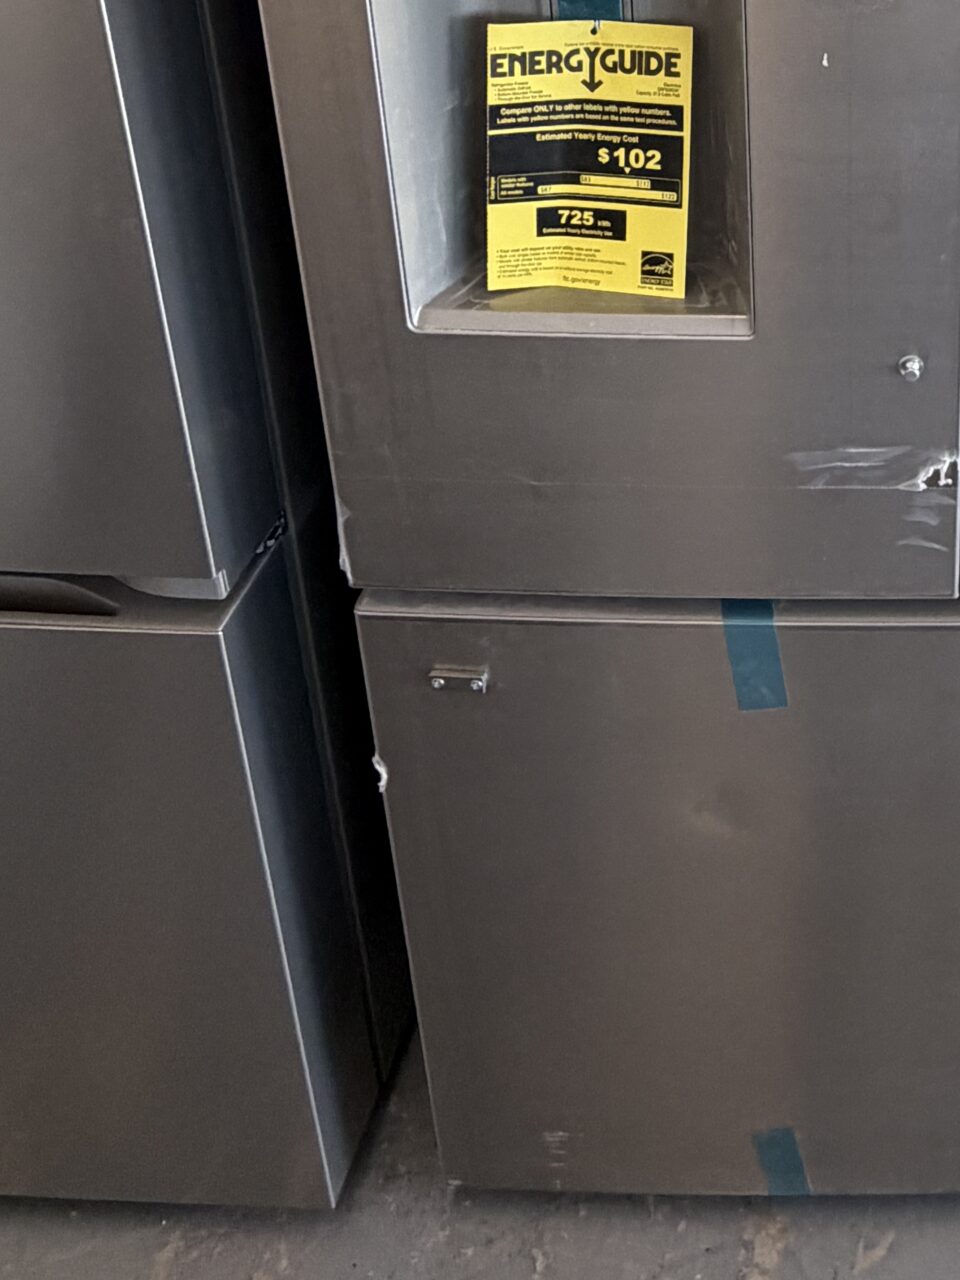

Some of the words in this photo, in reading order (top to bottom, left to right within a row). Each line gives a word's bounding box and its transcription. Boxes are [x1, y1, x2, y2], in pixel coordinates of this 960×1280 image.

[490, 47, 681, 78] ENERGYGUIDE
[500, 107, 532, 116] Compare
[533, 105, 554, 113] ONLY
[619, 106, 640, 114] yellow
[536, 132, 572, 142] Estimated
[574, 132, 595, 142] Yearly
[597, 133, 621, 143] Energy
[622, 135, 639, 143] Cost
[597, 147, 662, 170] $102
[558, 210, 594, 225] 725
